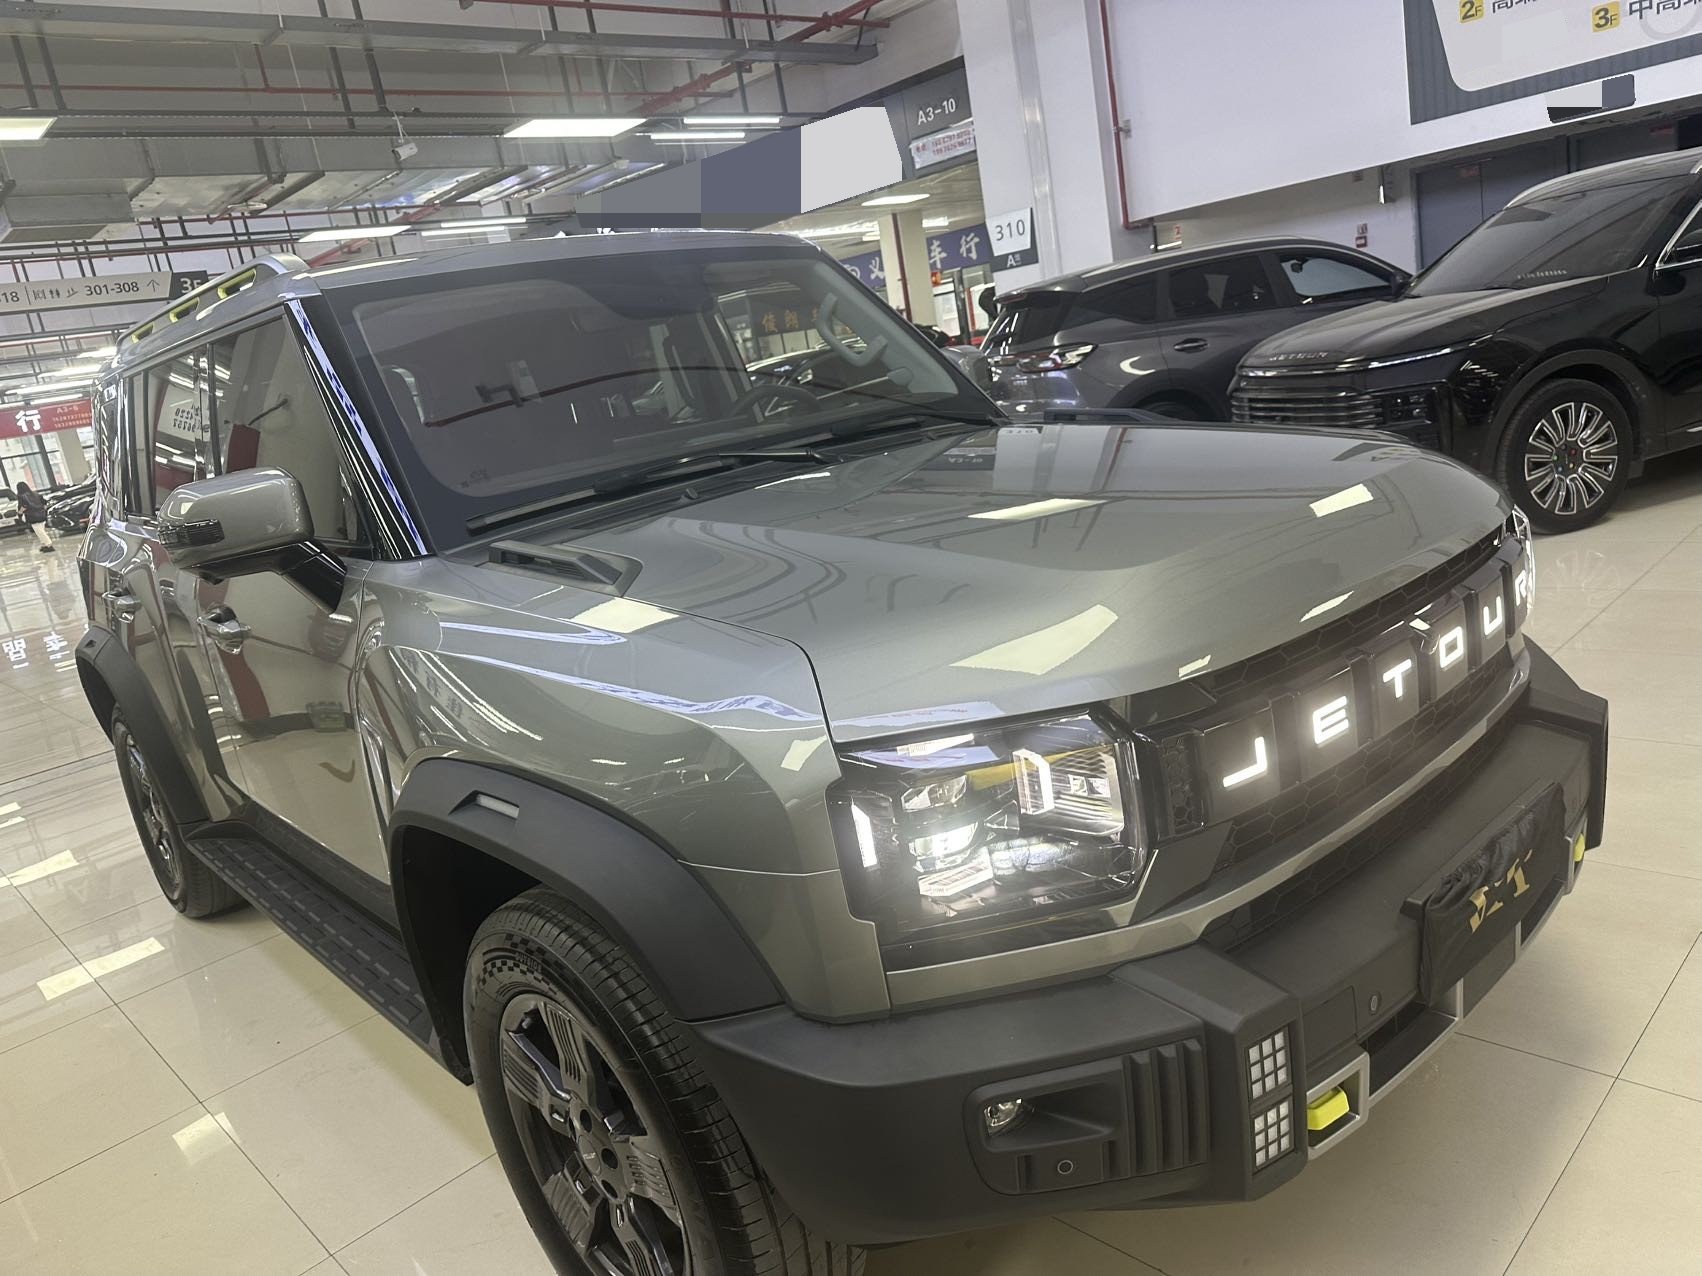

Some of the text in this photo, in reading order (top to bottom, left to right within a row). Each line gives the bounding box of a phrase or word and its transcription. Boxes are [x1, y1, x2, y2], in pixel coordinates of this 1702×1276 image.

[1594, 7, 1618, 29] 3F
[917, 98, 956, 125] A3-10
[994, 219, 1026, 241] 310
[0, 281, 139, 303] 18 301-308
[15, 410, 41, 432] 行
[1222, 569, 1528, 788] JETOUR
